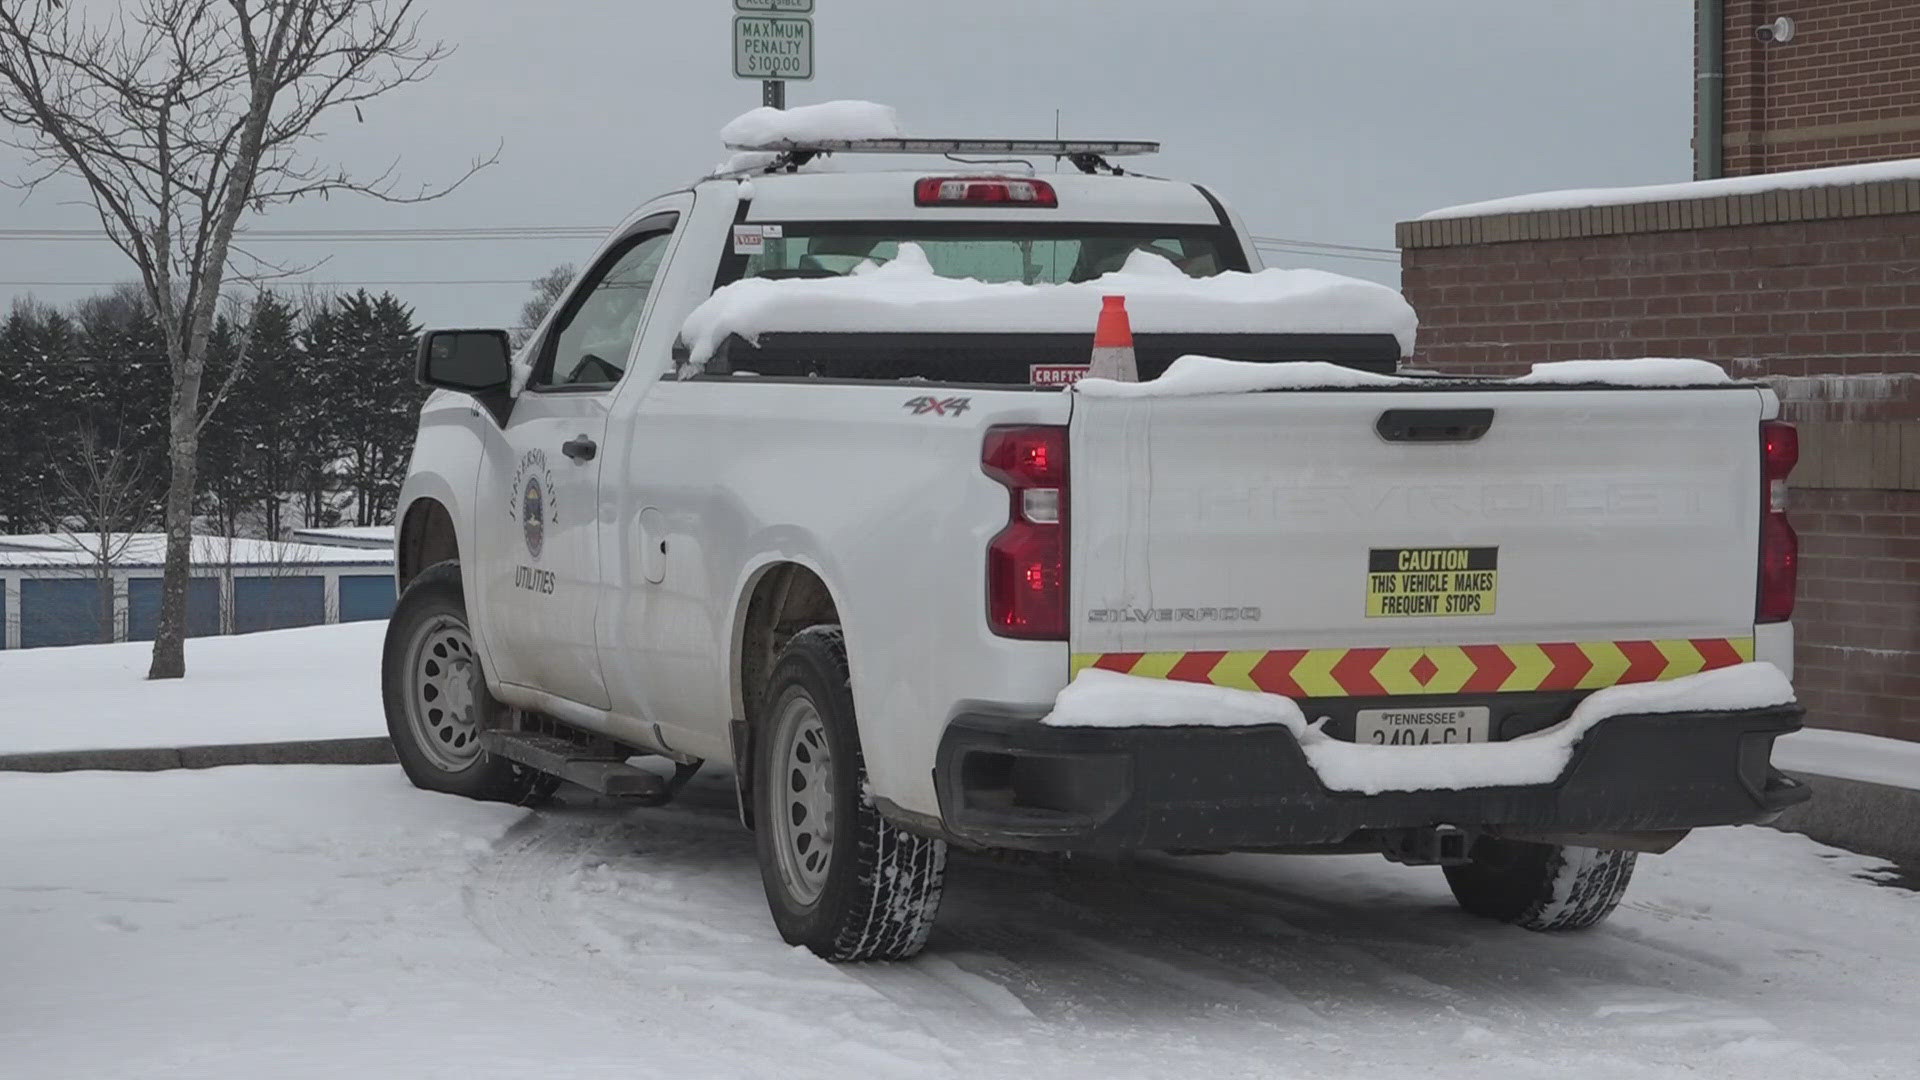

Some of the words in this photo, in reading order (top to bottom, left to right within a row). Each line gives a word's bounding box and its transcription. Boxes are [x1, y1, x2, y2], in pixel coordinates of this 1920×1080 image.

[742, 23, 804, 38] MAXIMUM
[745, 39, 801, 54] PENALTY
[748, 55, 800, 71] $100.00
[1398, 549, 1469, 571] CAUTION
[514, 564, 557, 595] UTILITIES
[1371, 574, 1397, 594] THIS
[1402, 574, 1449, 593] VEHICLE
[1454, 572, 1494, 592] MAKES
[1381, 594, 1440, 615] FREQUENT
[1445, 593, 1482, 613] STOPS
[1088, 606, 1262, 624] SILVERADO
[1387, 712, 1457, 725] TENNESSEE
